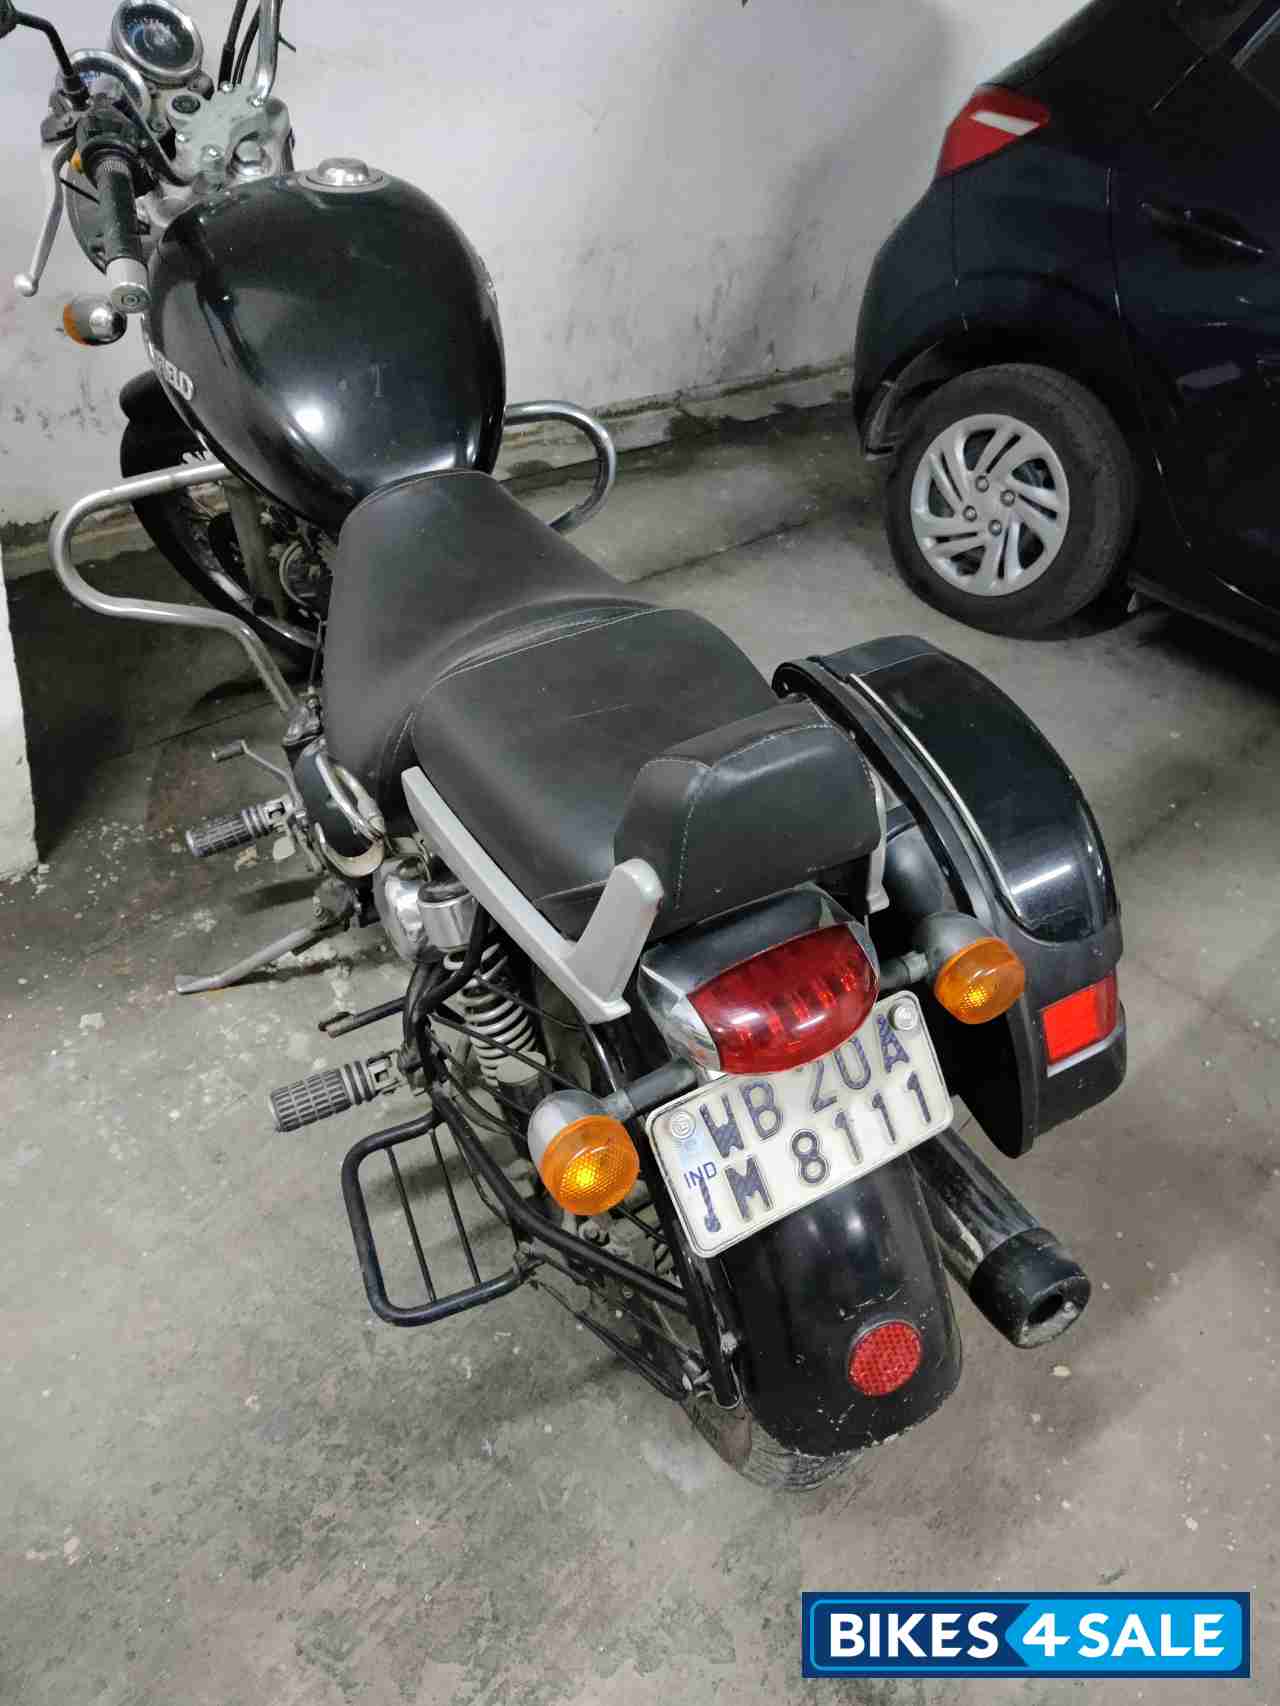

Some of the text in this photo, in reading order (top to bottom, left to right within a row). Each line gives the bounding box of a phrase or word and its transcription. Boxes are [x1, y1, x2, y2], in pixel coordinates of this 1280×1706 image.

[699, 1081, 784, 1158] WB
[791, 1071, 932, 1185] 8111
[683, 1161, 717, 1189] IND
